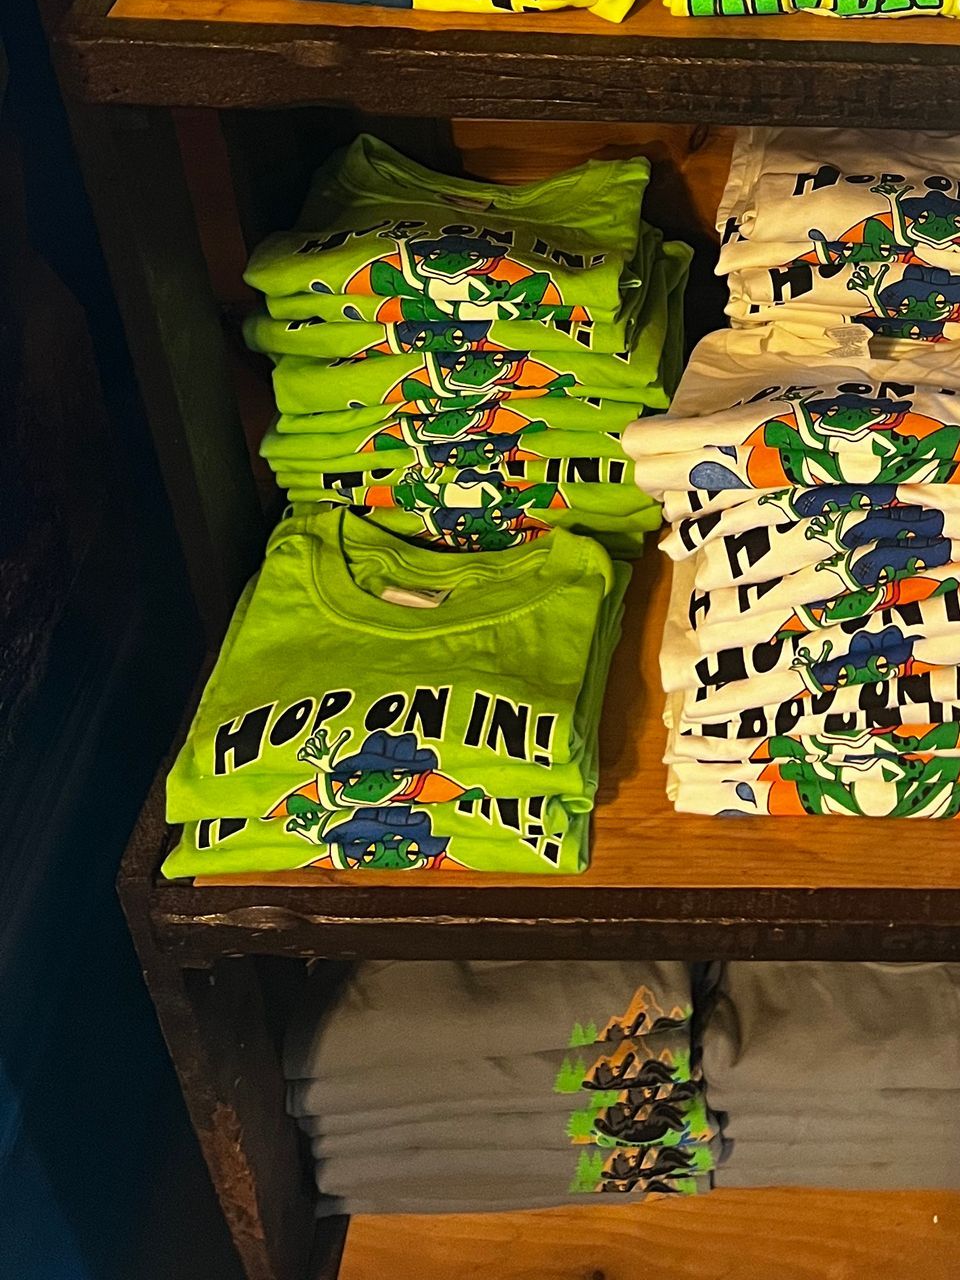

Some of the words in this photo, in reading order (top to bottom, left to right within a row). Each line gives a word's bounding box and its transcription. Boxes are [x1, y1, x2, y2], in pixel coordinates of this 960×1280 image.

[793, 165, 906, 196] HOP
[213, 690, 353, 777] HOP
[364, 687, 452, 741] ON
[463, 691, 557, 767] IN!
